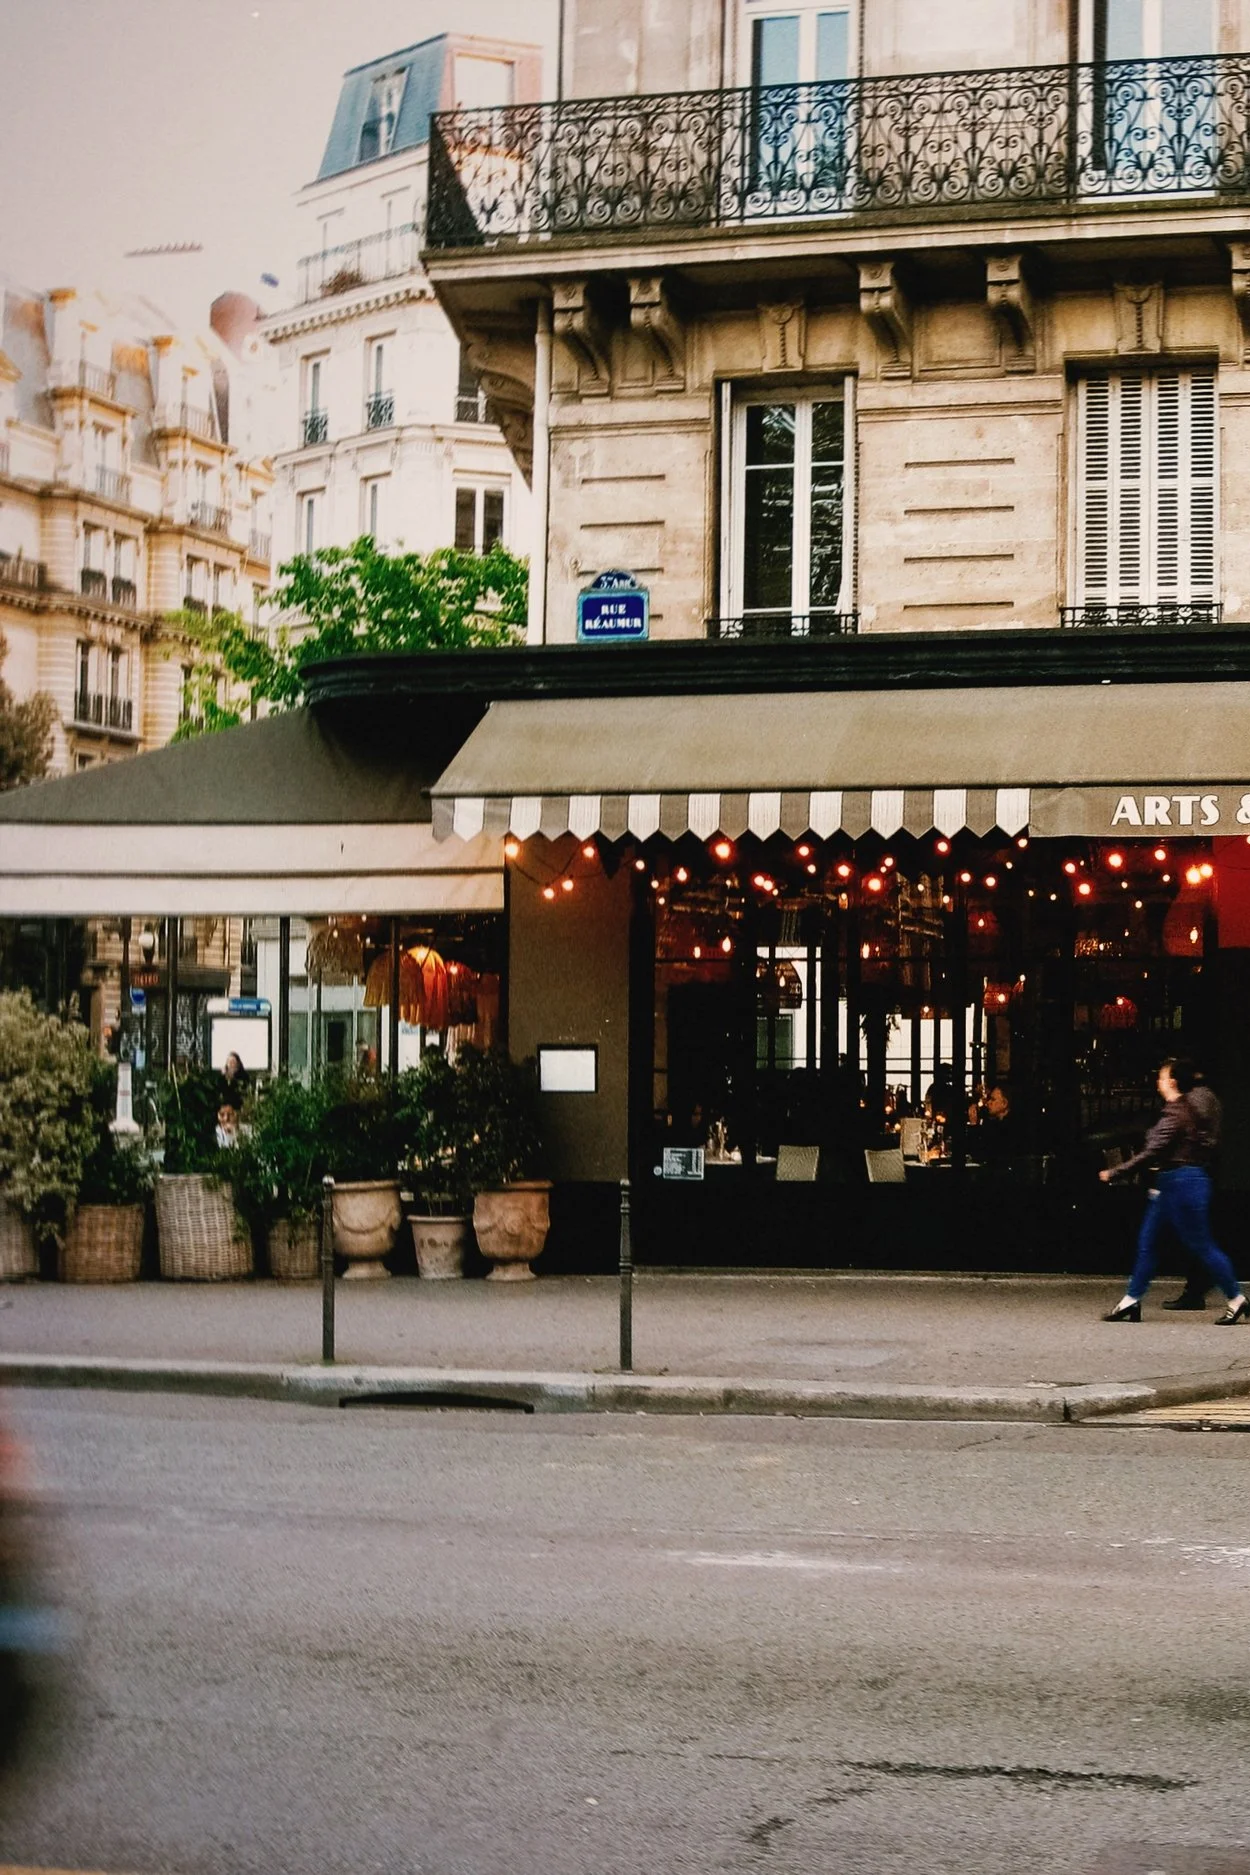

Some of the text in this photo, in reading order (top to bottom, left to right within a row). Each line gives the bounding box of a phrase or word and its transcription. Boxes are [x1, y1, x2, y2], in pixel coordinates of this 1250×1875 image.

[601, 604, 626, 615] RUE
[585, 616, 641, 629] RÉAUMUR
[1111, 795, 1221, 826] ARTS
